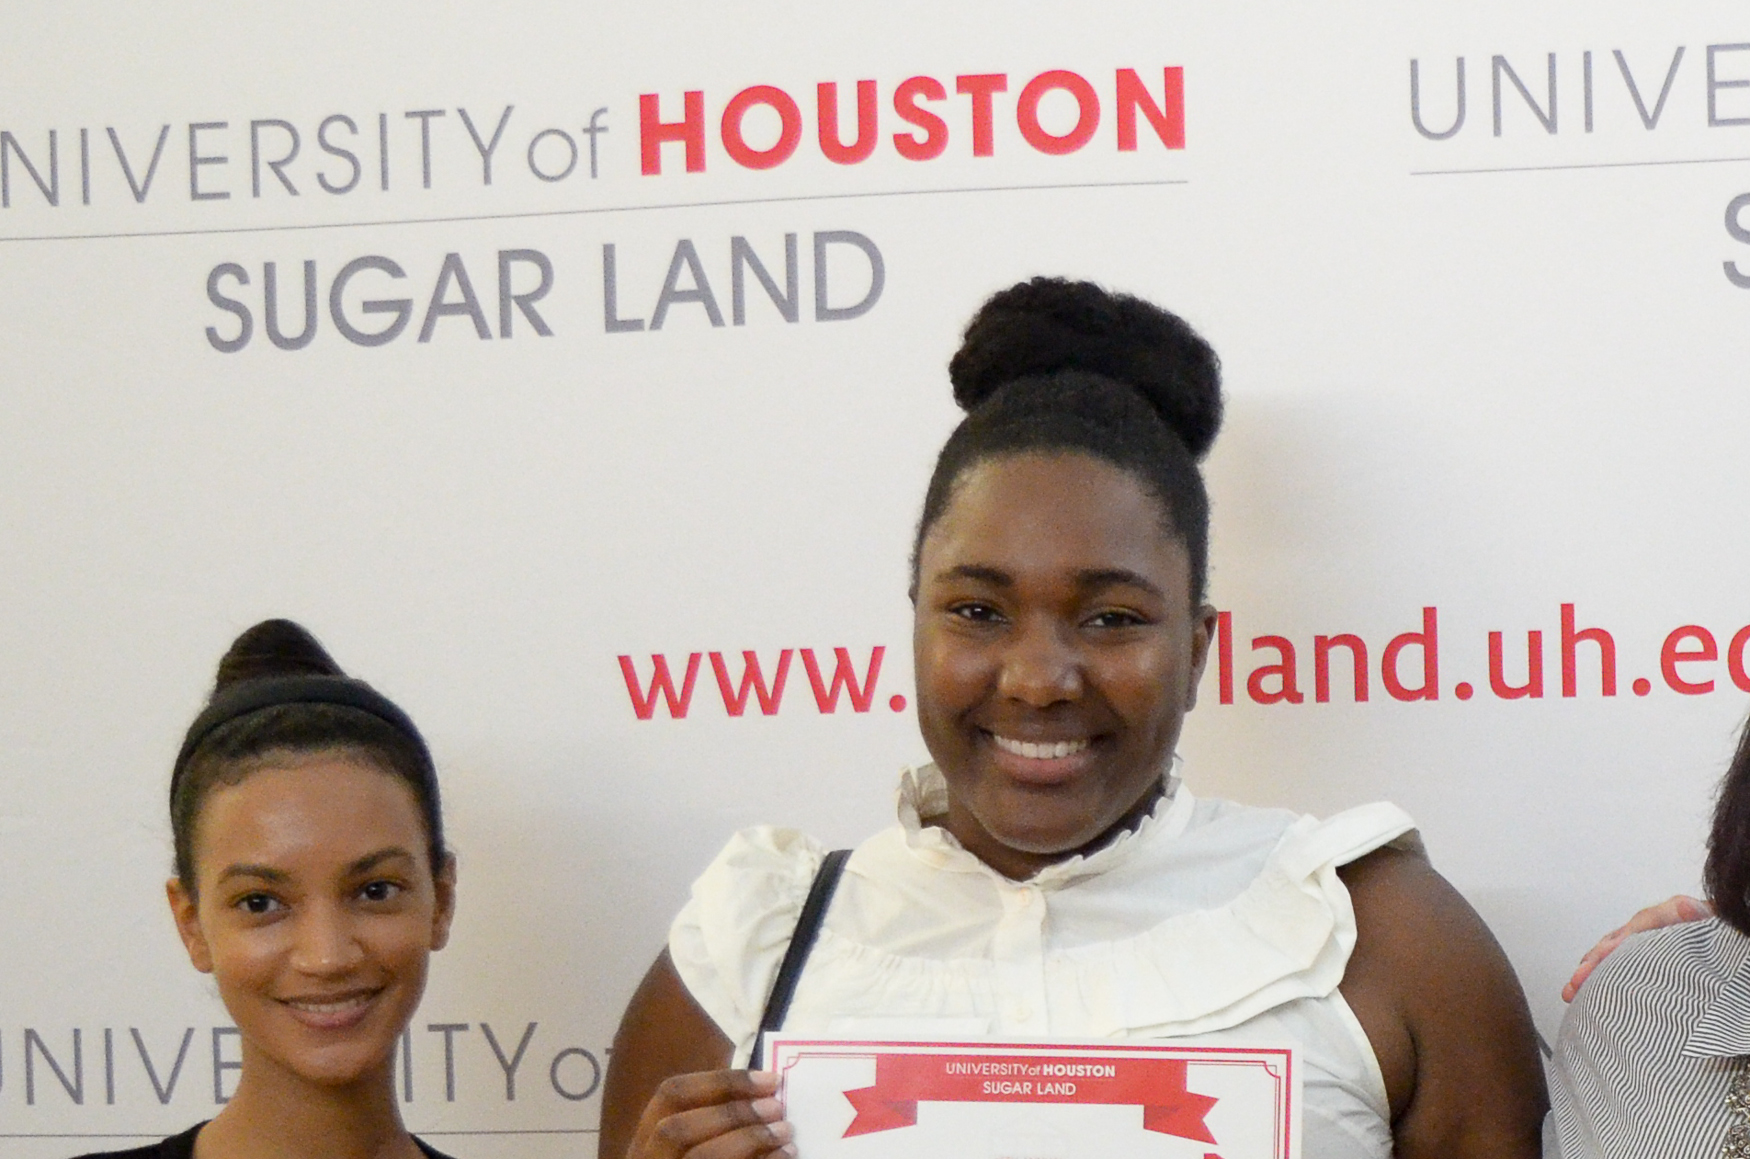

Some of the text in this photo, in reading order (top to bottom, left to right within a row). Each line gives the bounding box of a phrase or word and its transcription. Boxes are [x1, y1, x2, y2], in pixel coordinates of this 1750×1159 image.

[527, 107, 609, 183] of
[639, 66, 1186, 176] HOUSTON
[204, 230, 885, 354] SUGAR LAND
[946, 1062, 1116, 1077] UNIVERSITY of HOUSTON
[983, 1081, 1077, 1096] SUGAR LAND
